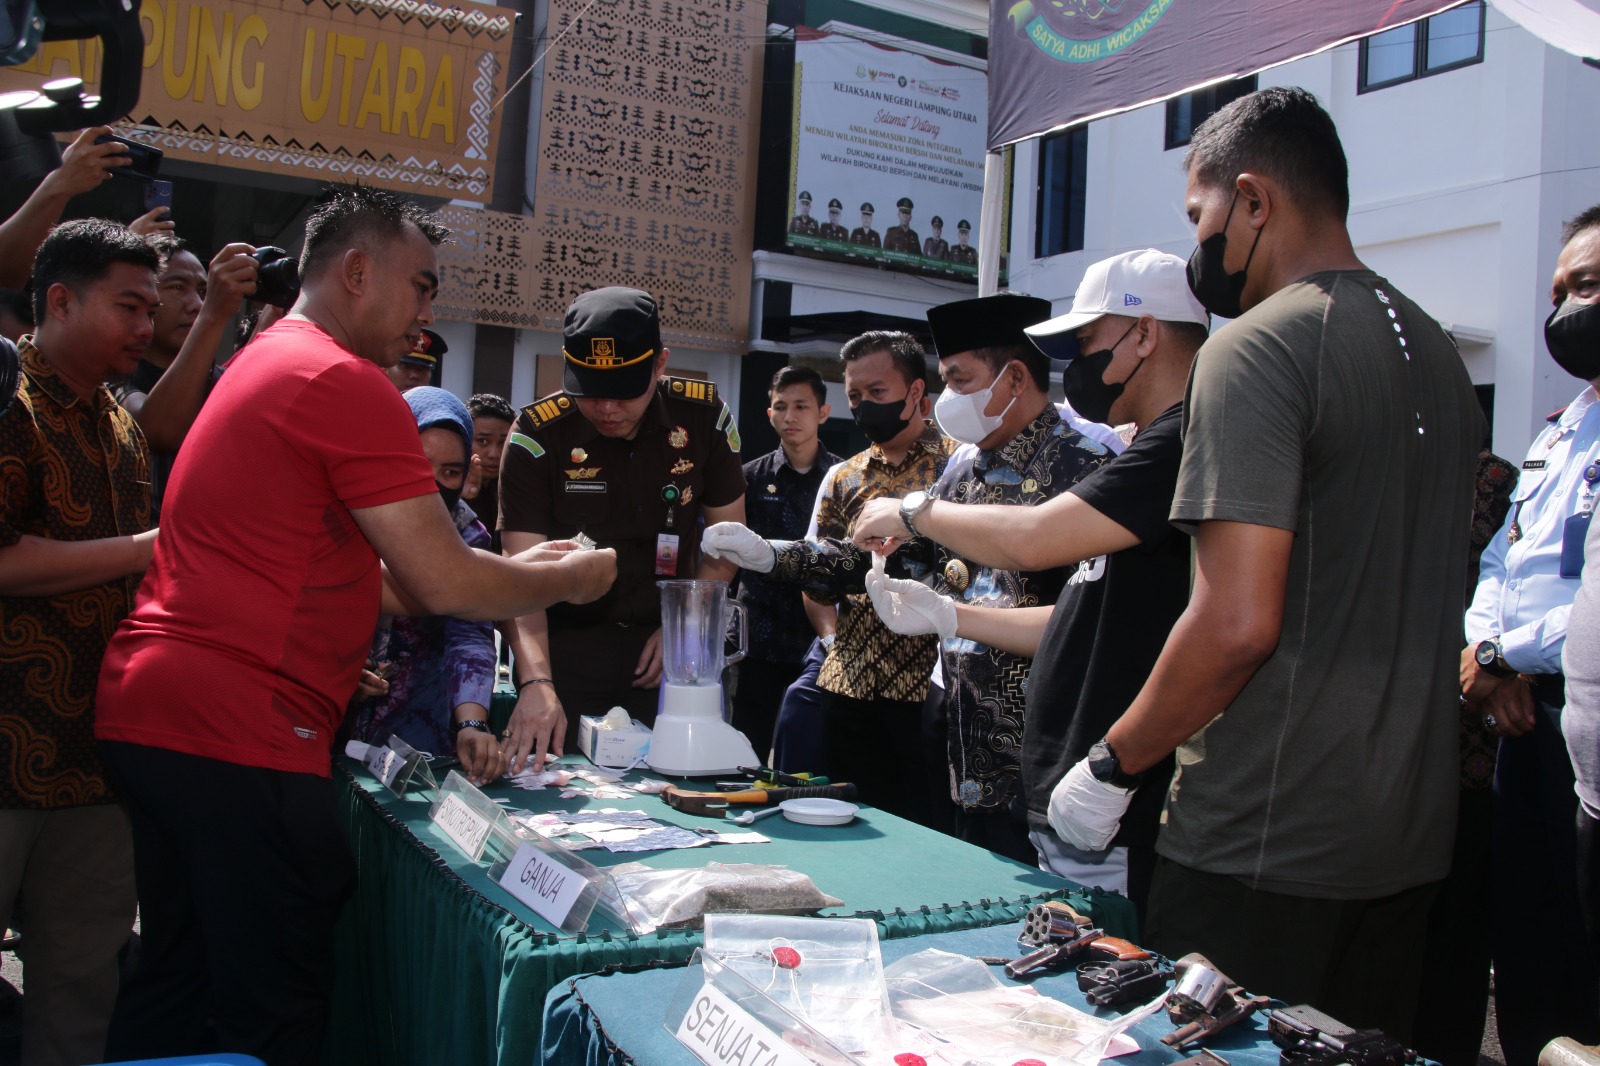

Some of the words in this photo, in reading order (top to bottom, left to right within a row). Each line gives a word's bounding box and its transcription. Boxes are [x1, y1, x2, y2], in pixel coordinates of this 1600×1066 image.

[1032, 23, 1065, 56] SATYA
[1068, 42, 1100, 59] ADHI
[301, 27, 455, 144] UTARA
[834, 82, 882, 101] KEJAKSAAN
[883, 93, 912, 109] NEGERI
[914, 101, 952, 117] LAMPUNG
[953, 110, 977, 123] UTARA
[849, 124, 867, 134] ANDA
[869, 129, 906, 143] MEMASUKI
[908, 136, 925, 147] ZONA
[926, 141, 962, 155] INTEGRITAS
[874, 109, 911, 127] Selamat
[910, 116, 940, 139] Datang
[805, 125, 834, 138] MENUJU
[836, 132, 867, 144] WILAYAH
[868, 139, 904, 153] BIROKRASI
[905, 146, 928, 158] BERSIH
[929, 152, 942, 161] DAN
[943, 155, 975, 168] MELAYANI
[846, 147, 875, 160] DUKUNG
[876, 154, 893, 164] KAMI
[894, 158, 917, 168] DALAM
[918, 163, 964, 178] MEWUJUDKAN
[820, 153, 852, 166] WILAYAH
[853, 159, 889, 173] BIROKRASI
[889, 167, 913, 178] BERSIH
[913, 171, 927, 181] DAN
[928, 175, 960, 188] MELAYANI
[525, 408, 541, 428] JAKSA
[441, 798, 486, 850] PSIKOTROPIKA
[520, 856, 566, 904] GANJA
